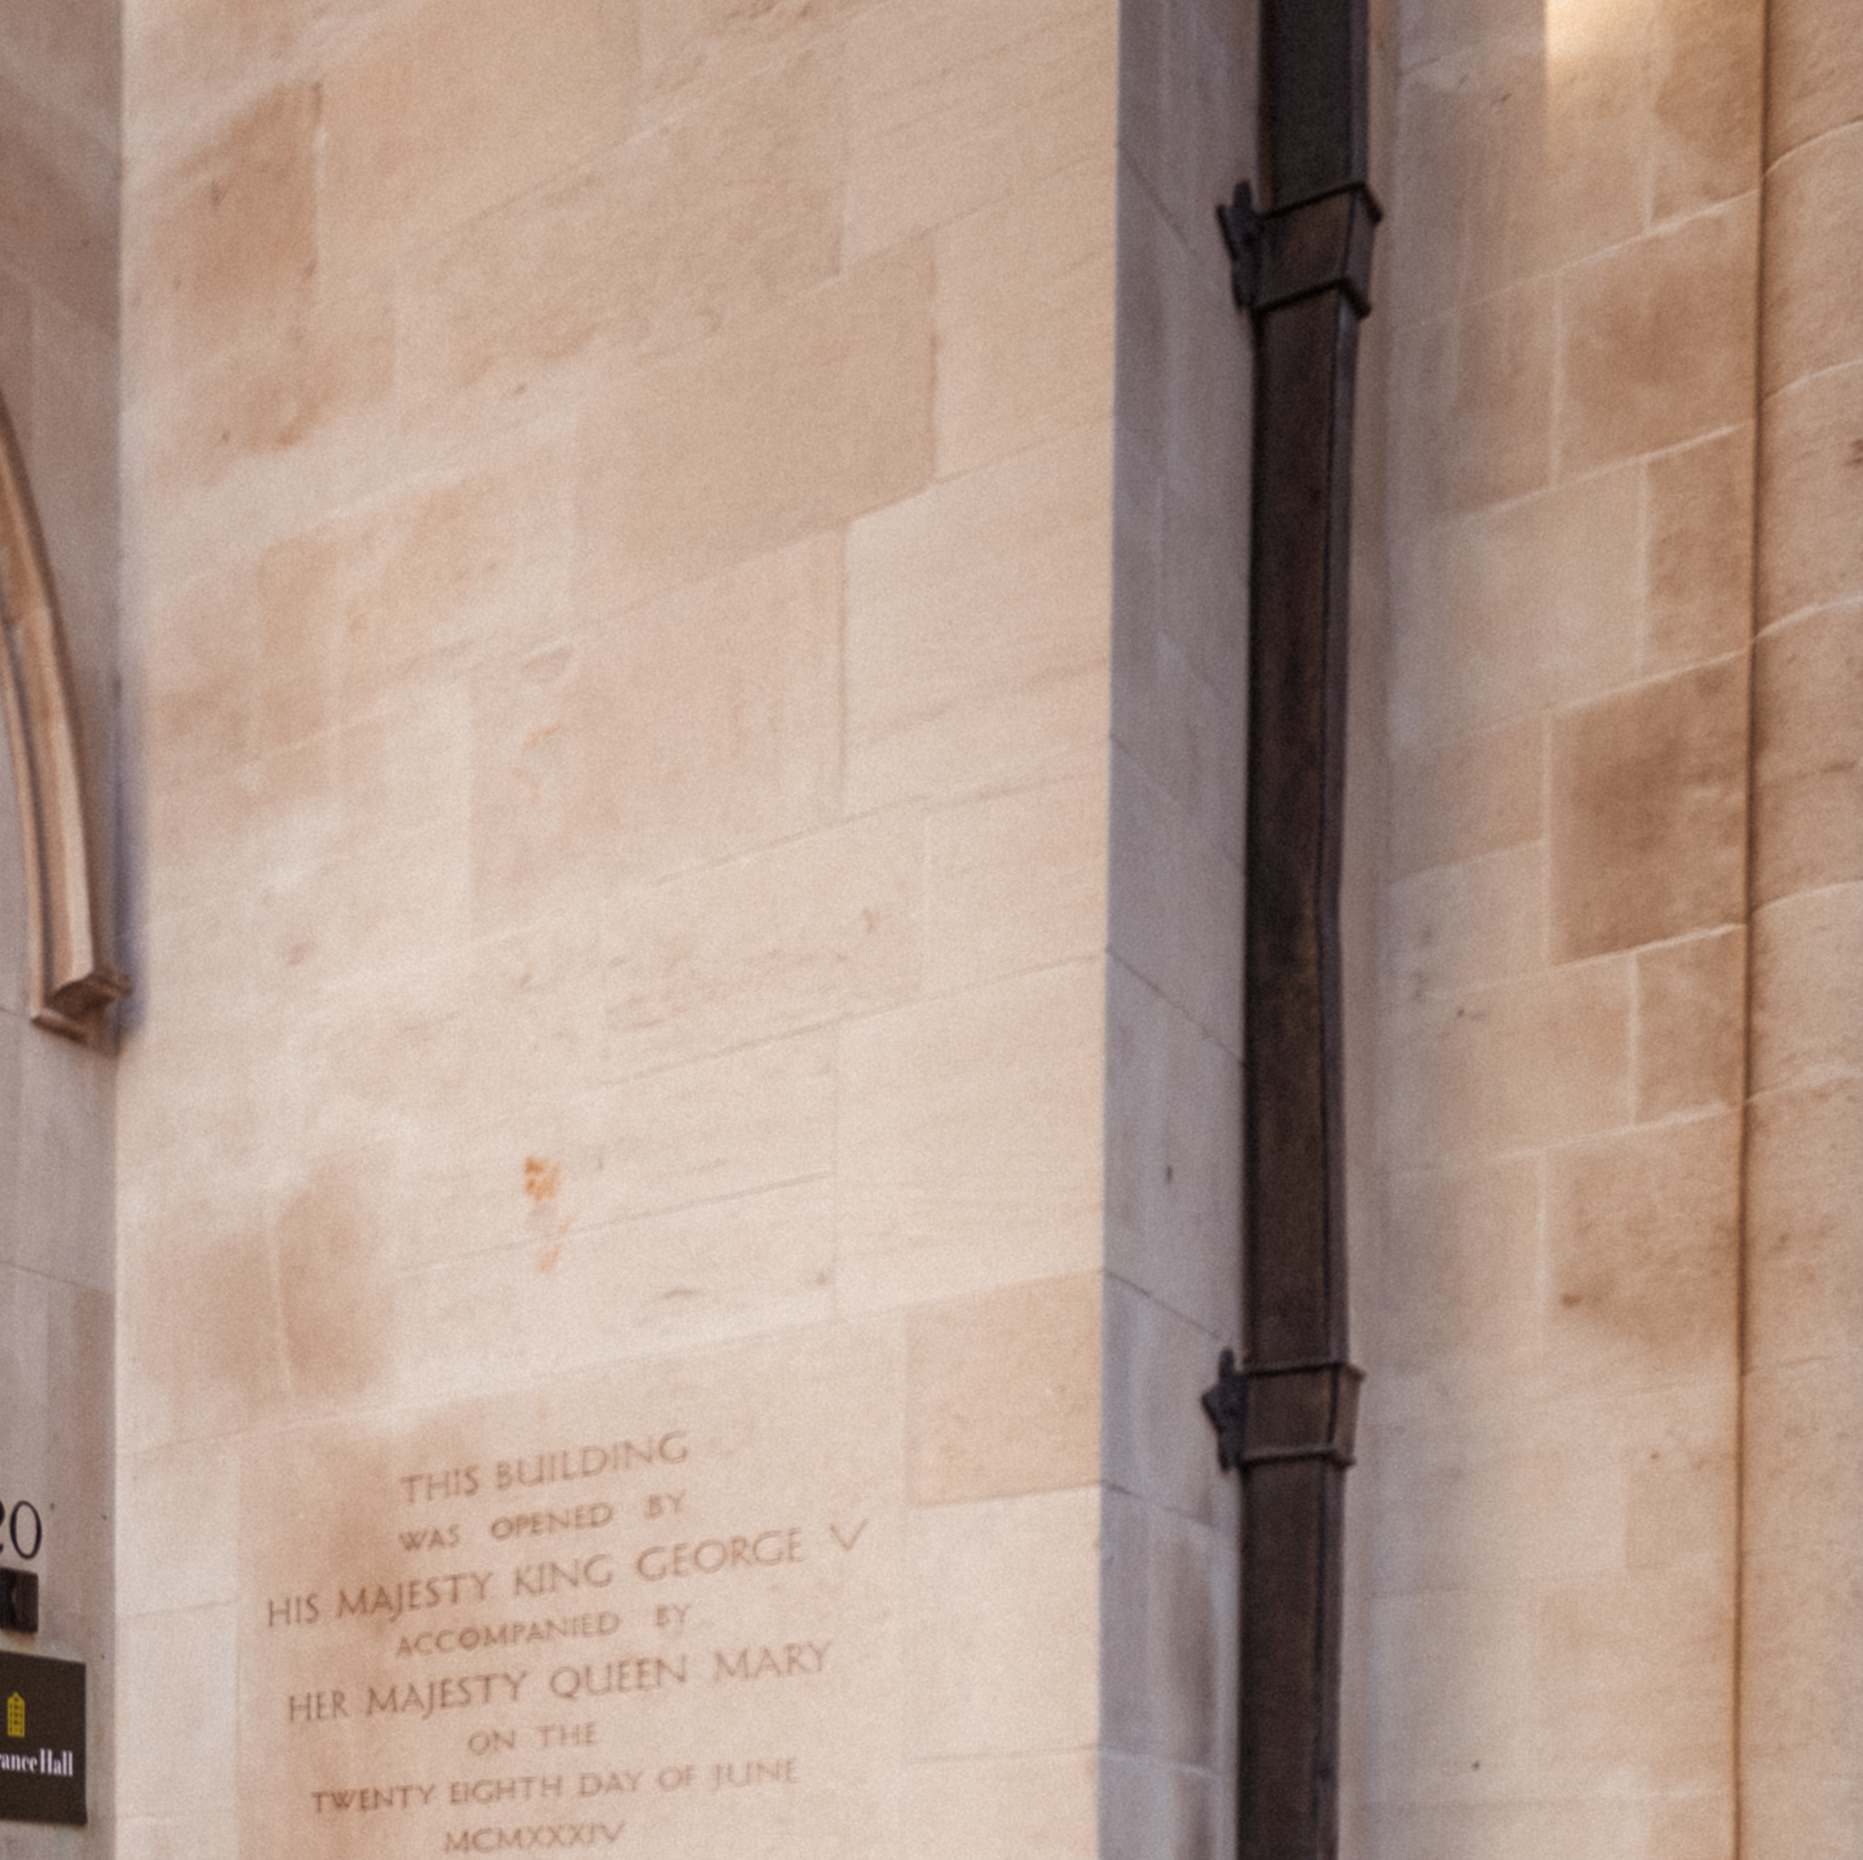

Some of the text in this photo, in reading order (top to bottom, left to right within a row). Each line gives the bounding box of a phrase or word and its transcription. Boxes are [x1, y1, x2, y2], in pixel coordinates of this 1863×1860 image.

[400, 1432, 688, 1503] THIS BUILDING
[399, 1491, 685, 1551] WAS OPENED BY
[266, 1522, 868, 1626] HIS MAJESTY KING GEORGE V
[397, 1605, 690, 1656] ACCOMPANIED BY
[288, 1642, 832, 1721] HER MAJESTY QUEEN MARY
[40, 1748, 73, 1776] Hall
[468, 1723, 596, 1754] ON THE
[311, 1760, 796, 1811] TWENTY EIGHTH DAY OF JUNE
[444, 1822, 625, 1852] MCMXXXIV
